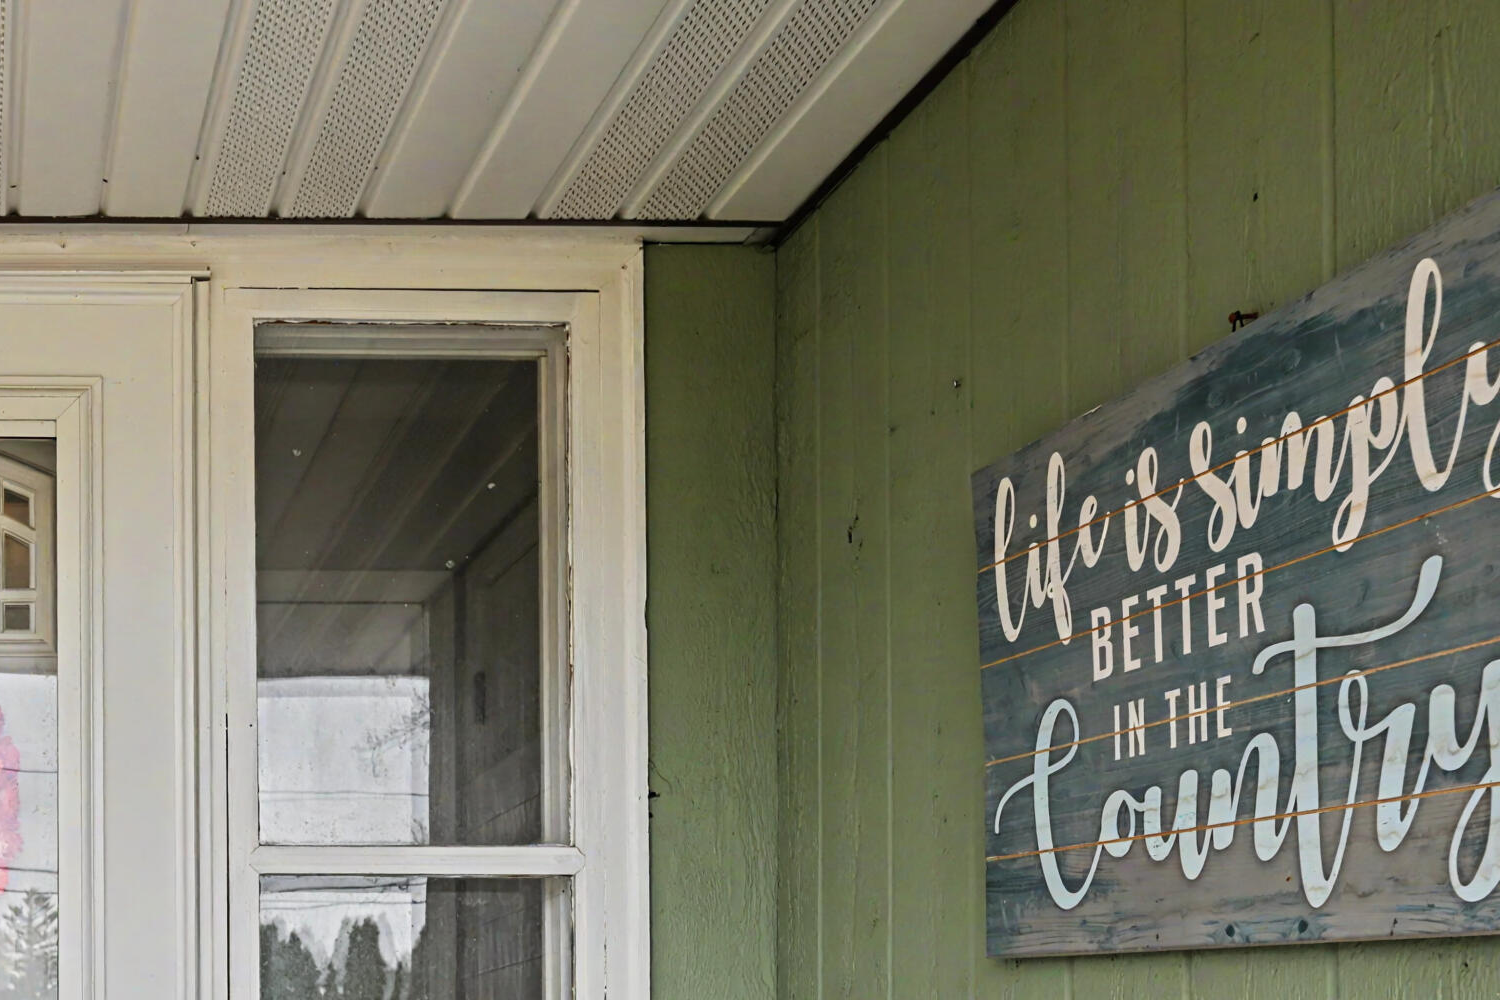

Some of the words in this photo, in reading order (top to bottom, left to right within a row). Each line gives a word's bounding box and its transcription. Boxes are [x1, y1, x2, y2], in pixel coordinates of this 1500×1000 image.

[995, 451, 1109, 645] life
[1125, 447, 1185, 573] is
[1091, 552, 1266, 682] BETTER
[995, 555, 1500, 909] Country
[1113, 704, 1147, 761] IN
[1165, 675, 1234, 749] THE
